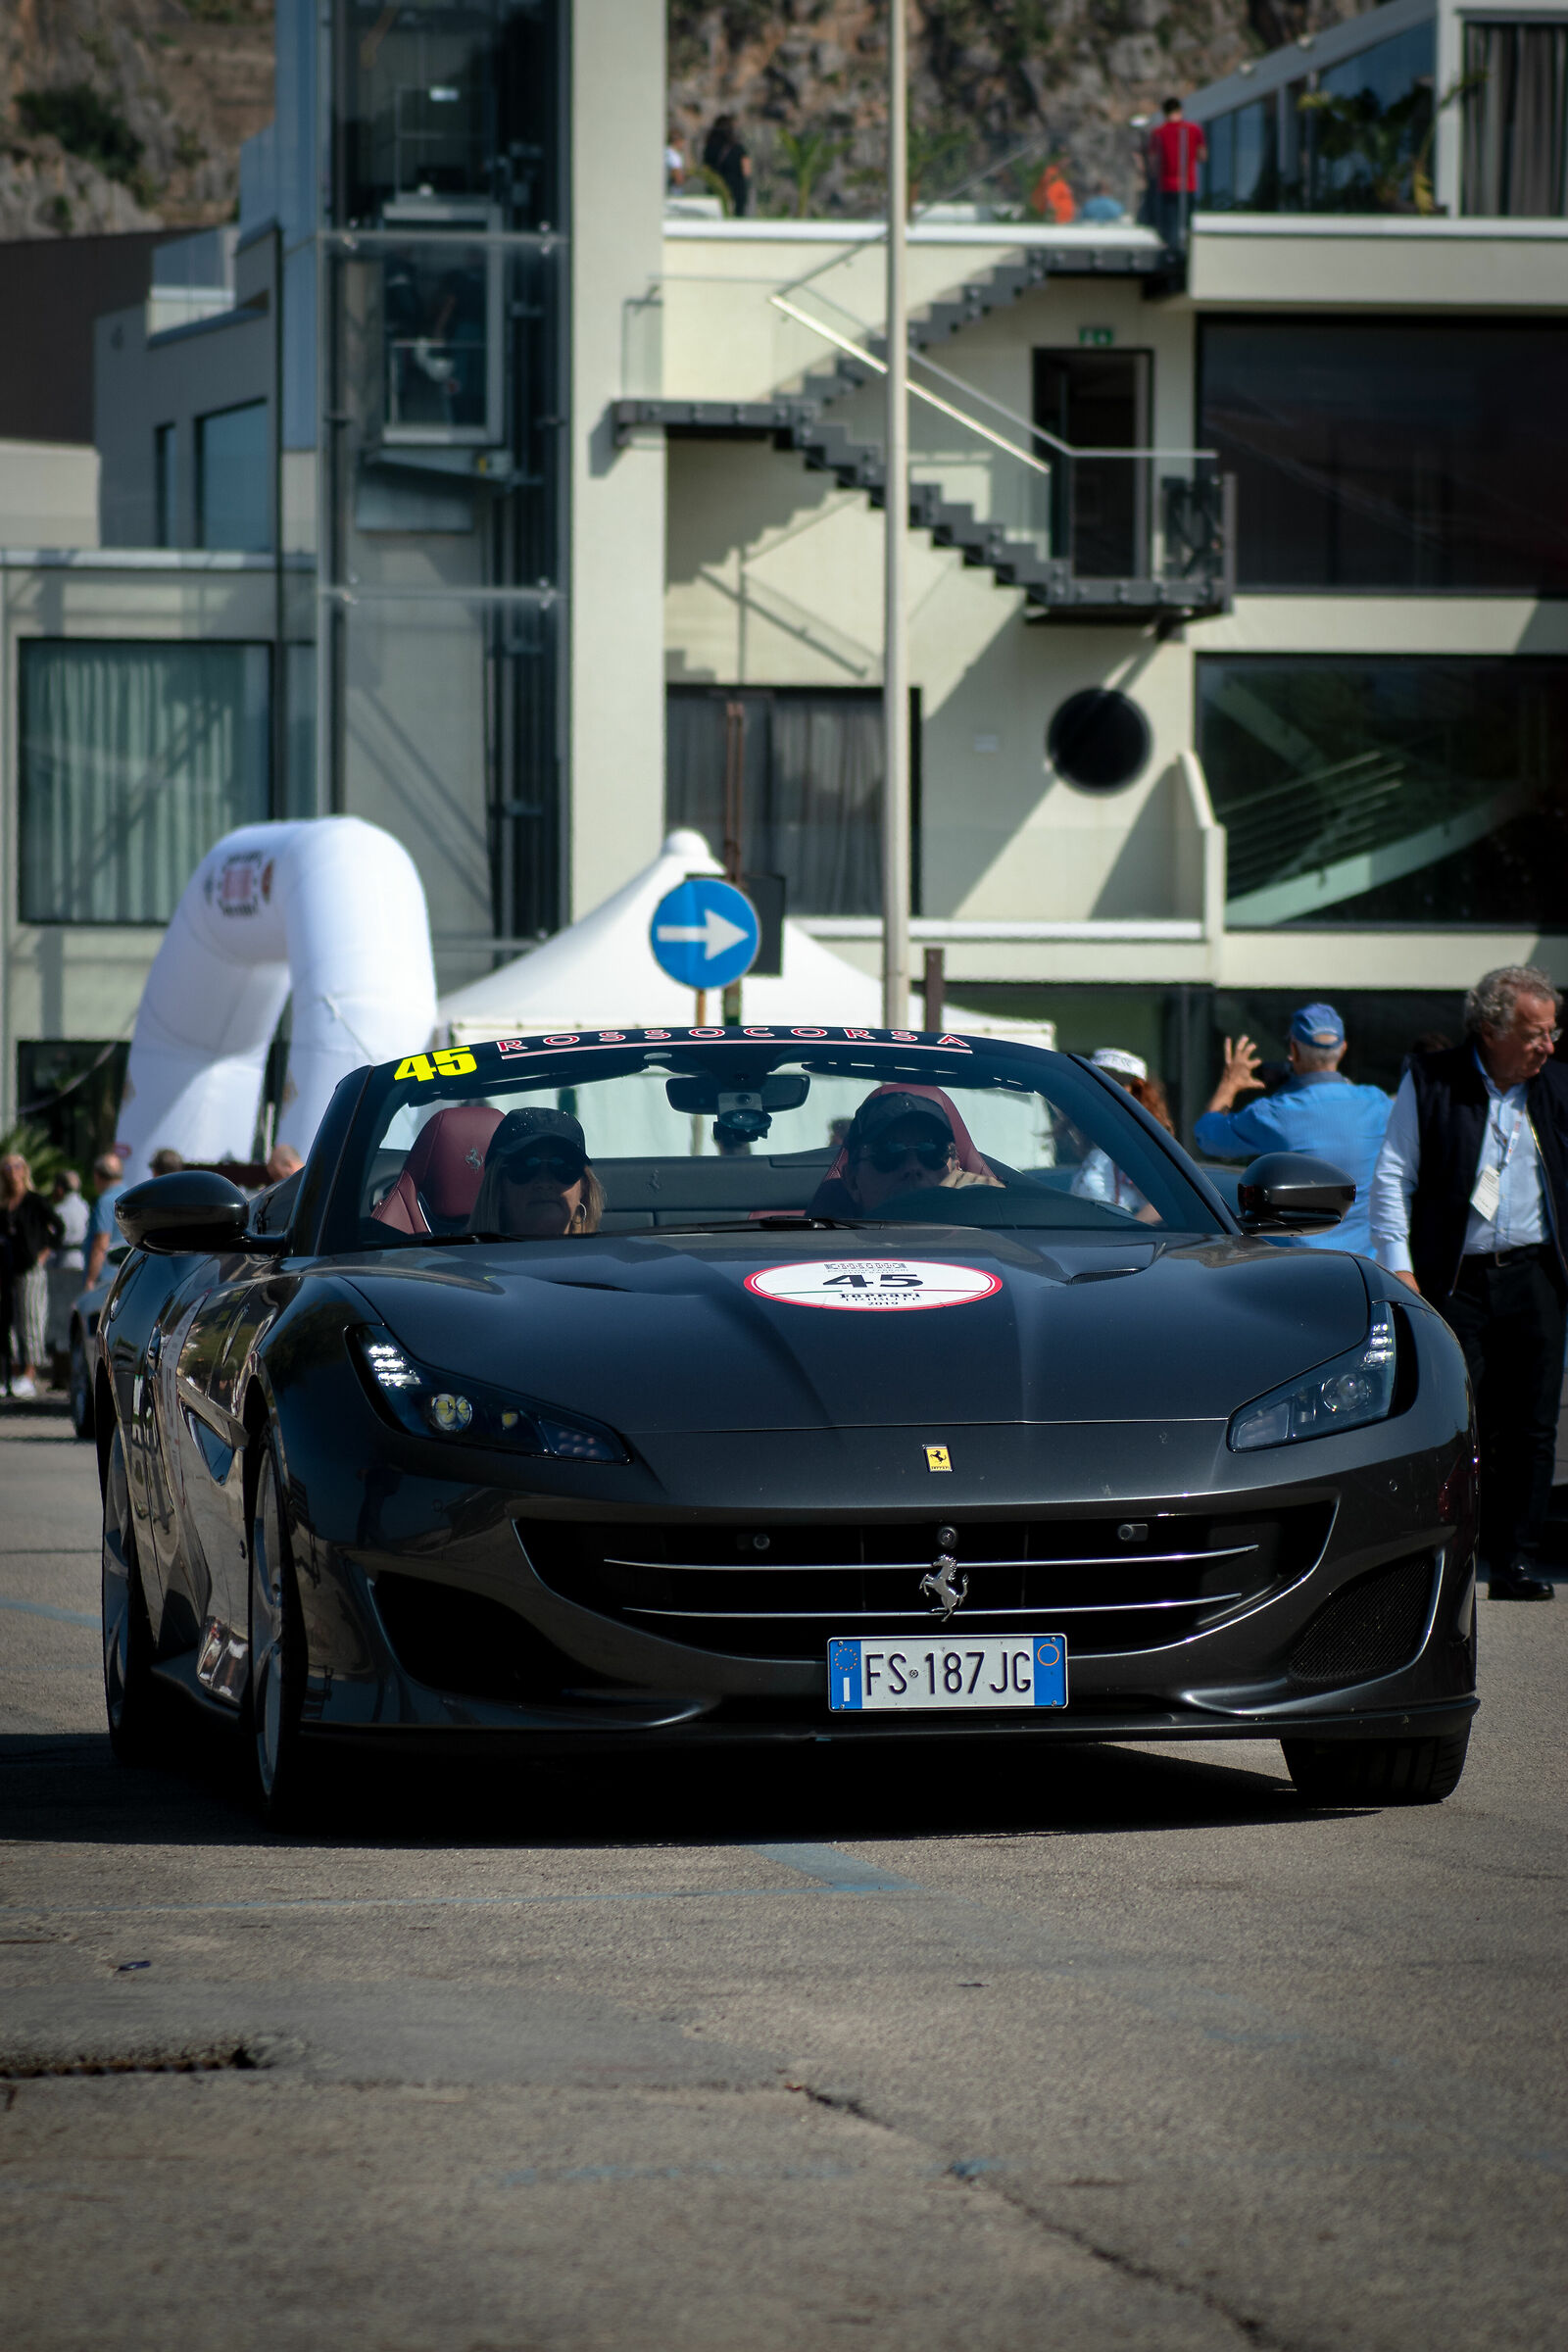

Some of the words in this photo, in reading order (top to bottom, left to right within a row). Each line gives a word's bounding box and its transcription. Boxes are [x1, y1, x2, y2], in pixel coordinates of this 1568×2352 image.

[496, 1027, 970, 1053] ROSSOCORSA
[393, 1047, 478, 1082] 45
[822, 1274, 924, 1288] 45
[864, 1652, 908, 1695] FS
[924, 1651, 985, 1694] 187
[989, 1651, 1032, 1693] JG
